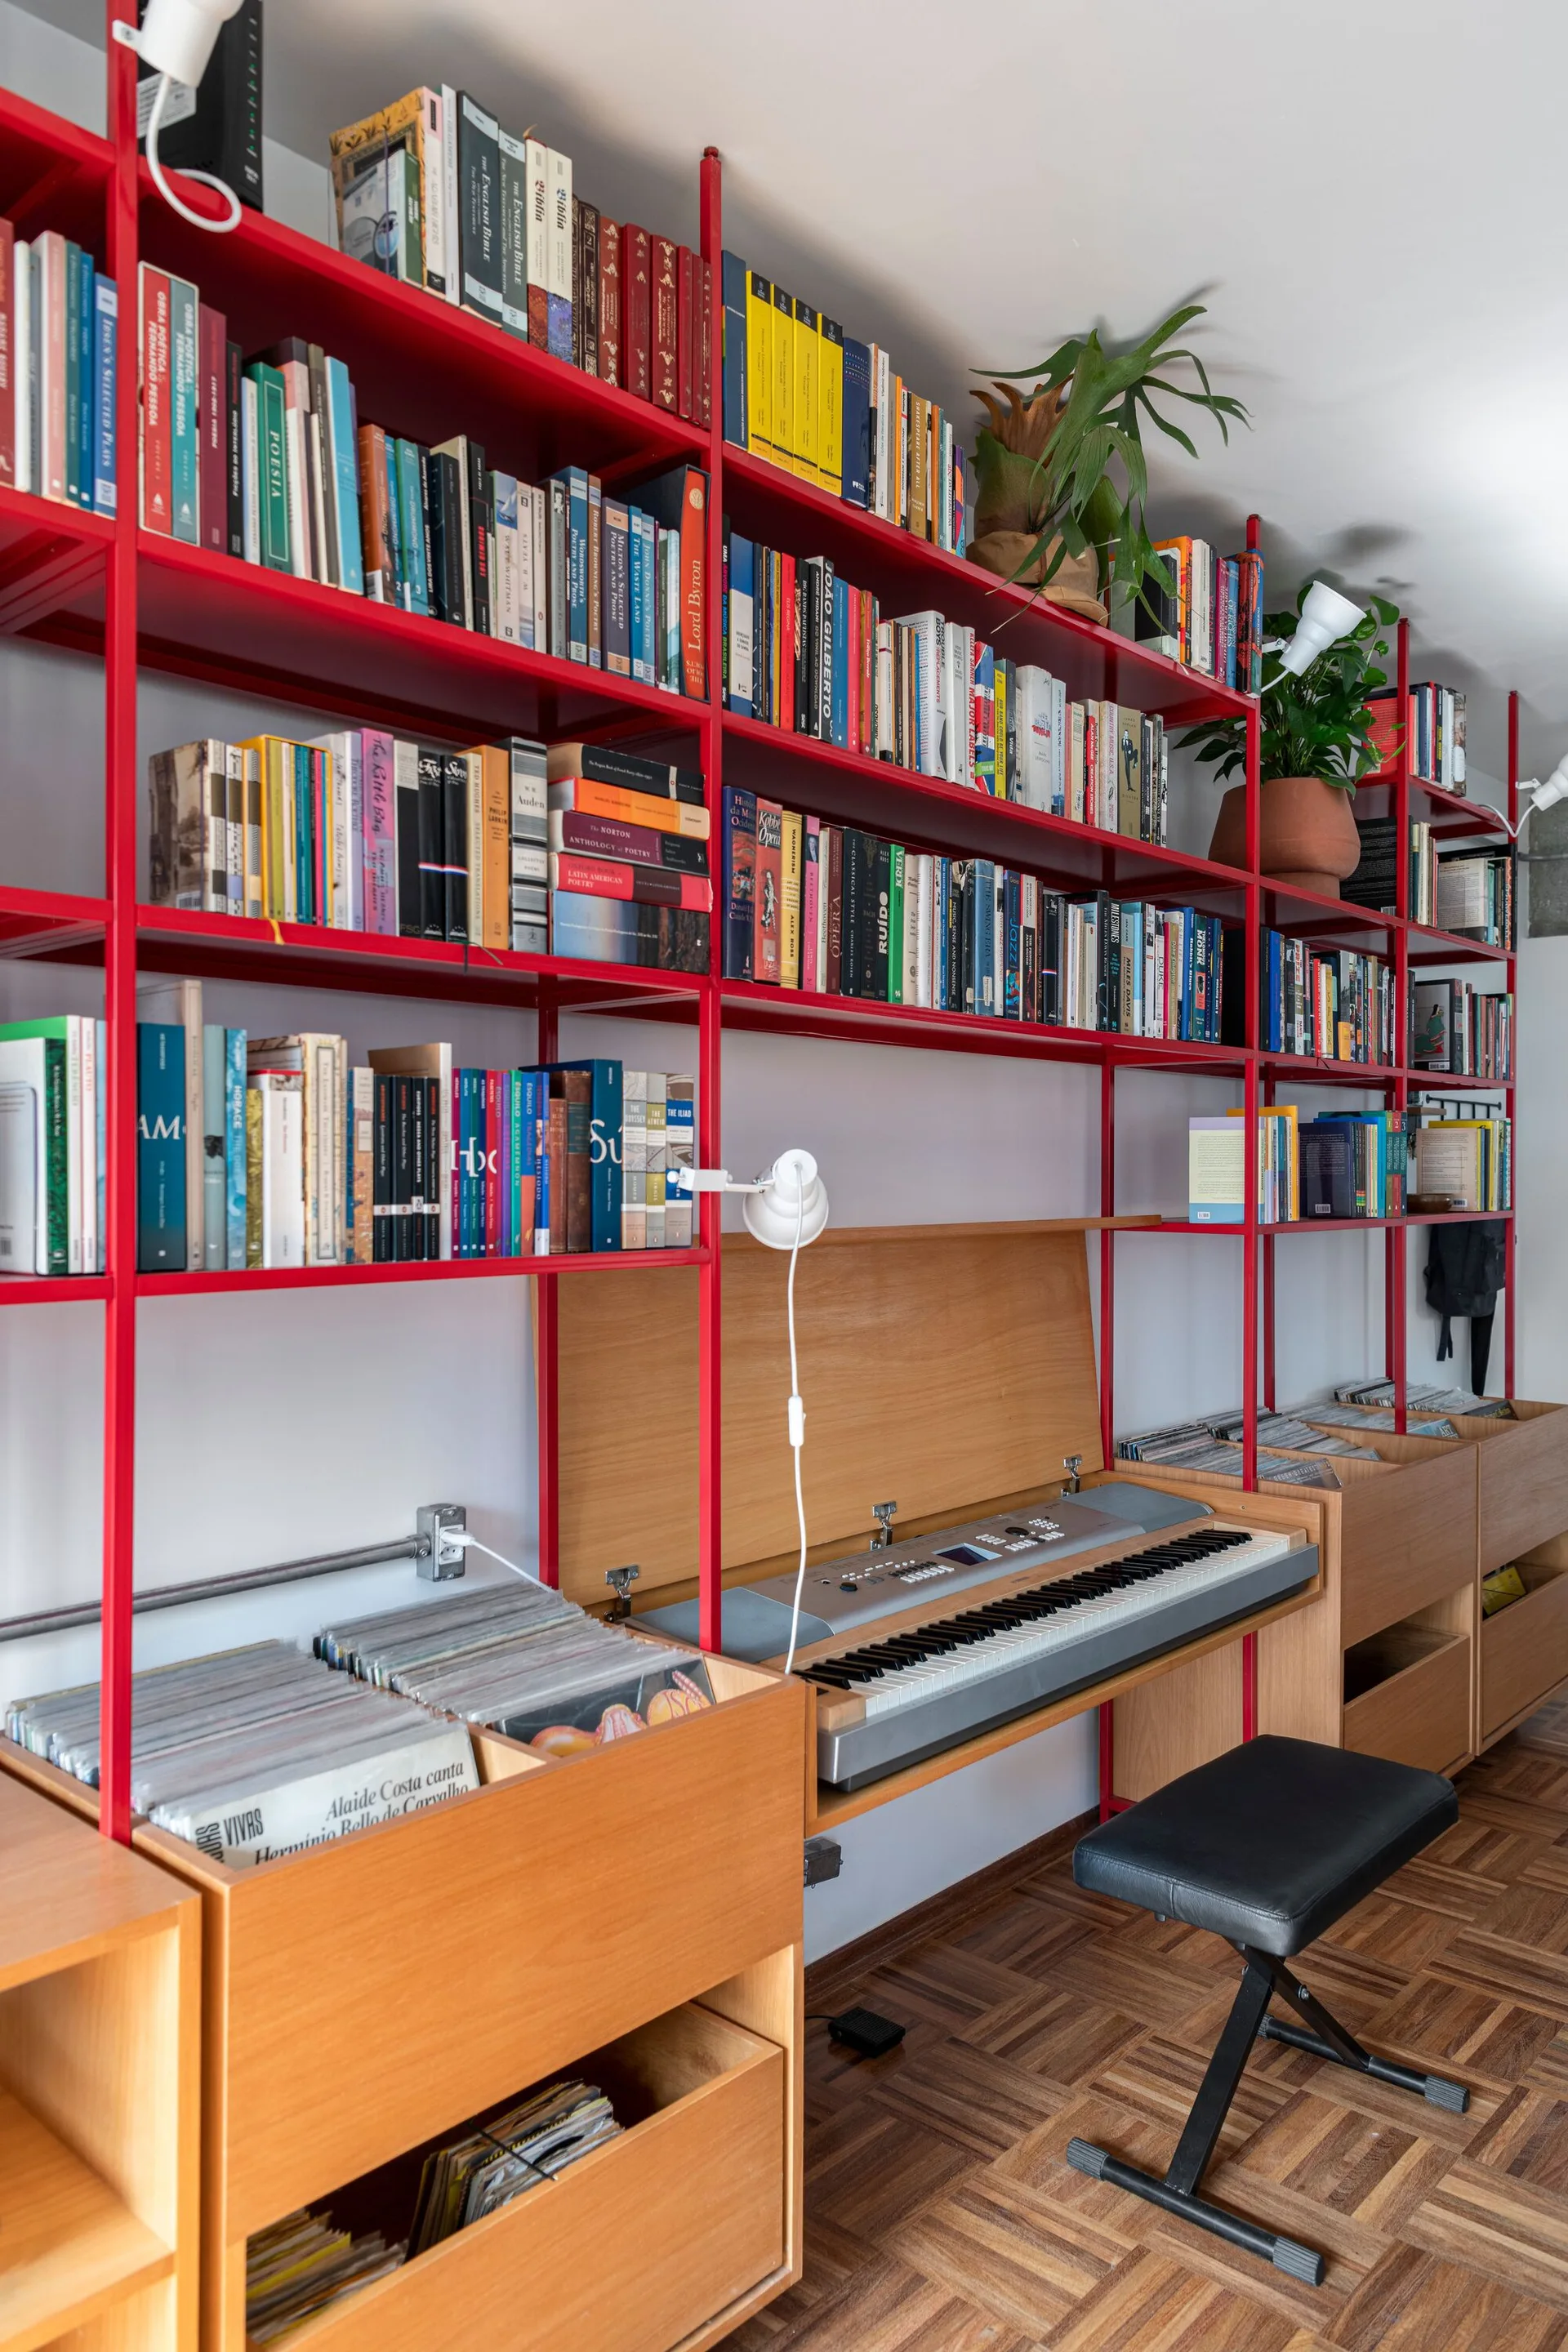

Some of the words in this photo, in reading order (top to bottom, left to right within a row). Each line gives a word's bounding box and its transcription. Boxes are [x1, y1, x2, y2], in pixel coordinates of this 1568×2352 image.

[482, 173, 491, 225] ENGLISH
[513, 198, 523, 248] ENGLISH
[483, 228, 492, 262] BIBLE
[514, 250, 523, 284] BIBLE
[157, 292, 167, 323] OBRA
[184, 304, 194, 335] OBRA
[148, 321, 158, 382] FERNANDO
[157, 326, 168, 373] POÉTICA
[176, 333, 185, 392] FERNANDO
[185, 337, 195, 382] POÉTICA
[148, 384, 158, 425] PESSOA
[176, 394, 185, 436] PESSOA
[270, 430, 283, 498] POESIA
[410, 501, 418, 549] DRUMMOND
[688, 560, 701, 604] Byron
[722, 595, 728, 605] DA
[823, 563, 833, 615] JOÃO
[688, 612, 701, 653] Lord
[814, 626, 818, 636] DO
[814, 657, 818, 667] AO
[822, 621, 832, 719] GILBERTO
[519, 795, 545, 808] Auden
[569, 836, 615, 851] ANTHOLOGY
[625, 847, 652, 858] POETRY
[601, 826, 630, 839] NORTON
[568, 871, 589, 880] LATIN
[589, 873, 623, 884] AMERICAN
[568, 879, 595, 889] POETRY
[895, 849, 904, 889] VERDI
[831, 896, 840, 958] ÓPERA
[877, 892, 889, 954] RUÍDO
[1111, 902, 1119, 943] MILESTONES
[234, 1085, 242, 1129] HORACE
[667, 1108, 677, 1117] THE
[678, 1108, 692, 1118] ILIAD
[326, 1788, 376, 1820] Alaide
[380, 1775, 421, 1802] Costa
[425, 1762, 464, 1787] canta
[224, 1808, 265, 1846] VIVAS
[255, 1830, 336, 1865] Hermínio
[341, 1811, 379, 1838] Bello
[382, 1806, 399, 1820] de
[403, 1783, 468, 1814] Carvalho
